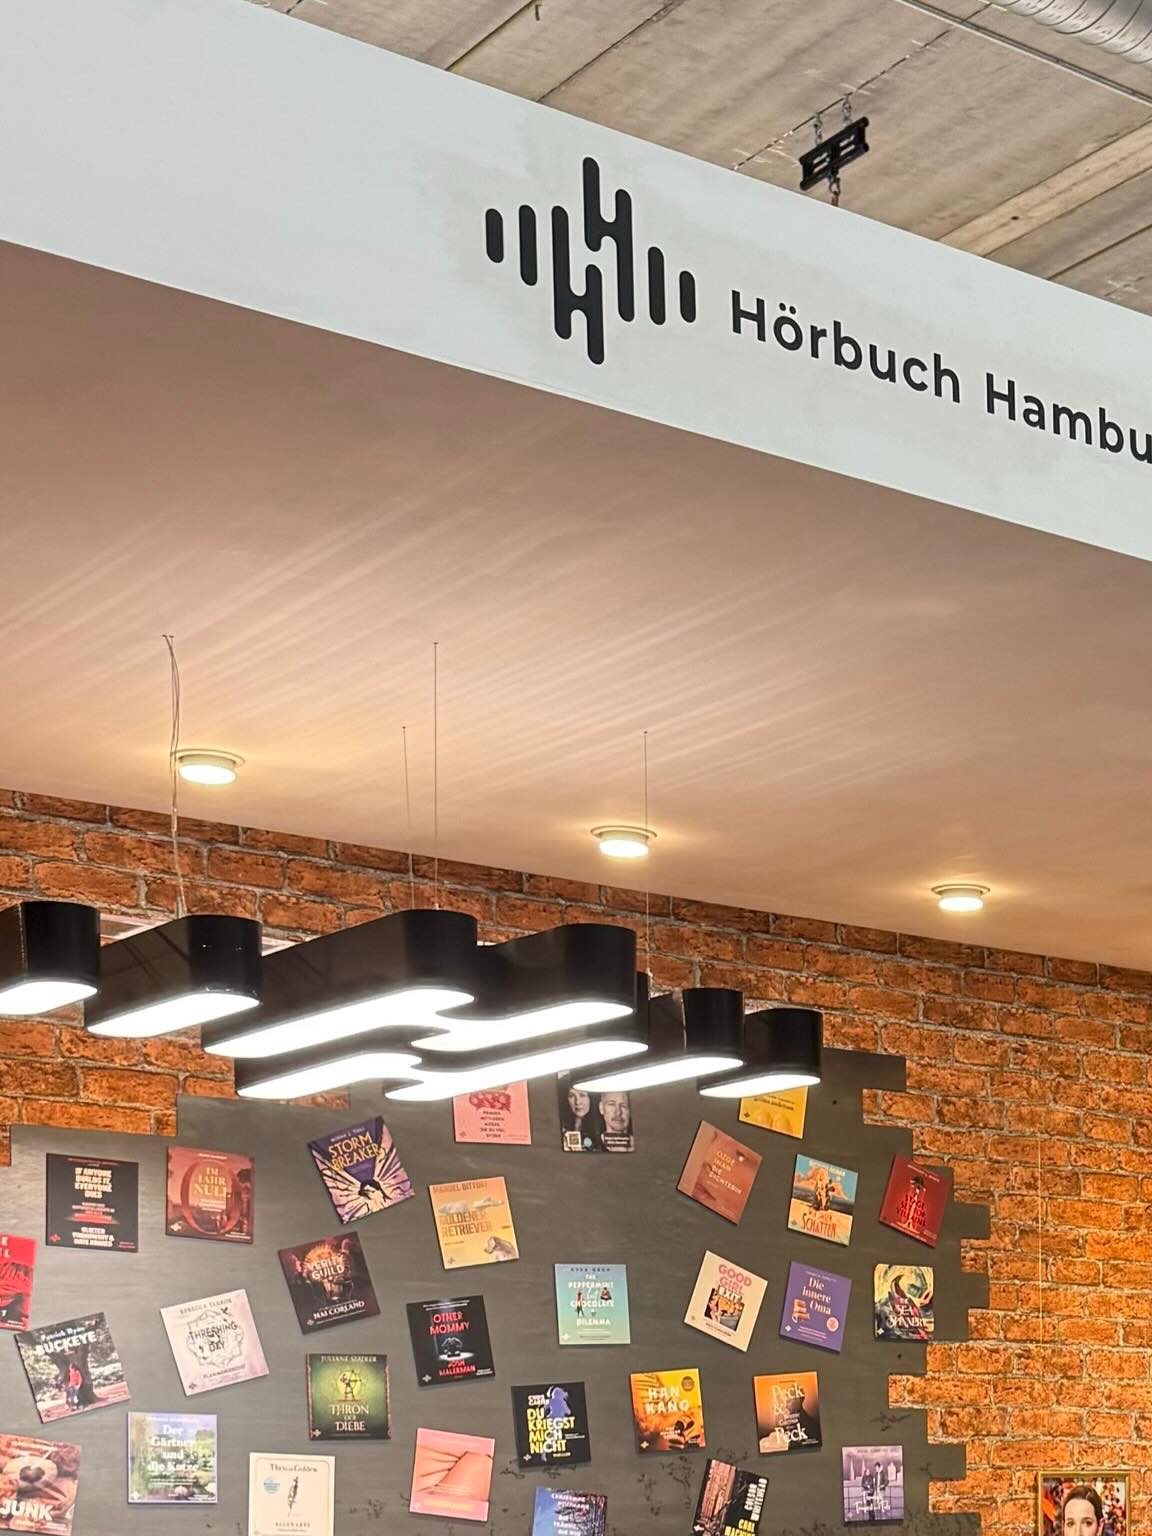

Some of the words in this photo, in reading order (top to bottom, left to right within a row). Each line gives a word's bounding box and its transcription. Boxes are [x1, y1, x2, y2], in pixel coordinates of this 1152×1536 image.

[731, 290, 961, 403] Hörbuch
[329, 1131, 373, 1158] STORM
[331, 1143, 384, 1170] BREAKER
[75, 1184, 113, 1193] EVERYONE
[441, 1222, 494, 1238] RETRIEVER
[800, 1212, 837, 1238] SCHATTEN
[312, 1264, 345, 1280] GUILD
[719, 1264, 752, 1287] GOOD
[569, 1281, 614, 1289] PEPPERMINT
[720, 1276, 745, 1295] GIRL
[809, 1277, 825, 1291] Die
[810, 1300, 832, 1316] Oma
[433, 1311, 463, 1323] OTHER
[576, 1318, 611, 1326] DILEMMA
[190, 1321, 239, 1343] THRESHING
[430, 1321, 470, 1336] MOMMY
[34, 1330, 97, 1356] BUCKEYE
[208, 1340, 226, 1353] DAY
[648, 1386, 680, 1400] HAN
[772, 1382, 806, 1401] Peck
[328, 1403, 369, 1415] THRON
[527, 1407, 545, 1420] DU
[645, 1400, 690, 1416] KANG
[163, 1424, 184, 1435] Der
[335, 1420, 365, 1432] DIEBE
[528, 1416, 576, 1431] KRIEGST
[529, 1429, 563, 1442] MICH
[775, 1423, 808, 1444] Peck
[162, 1450, 184, 1459] und
[530, 1440, 567, 1454] NICHT
[1, 1500, 53, 1521] JUNK
